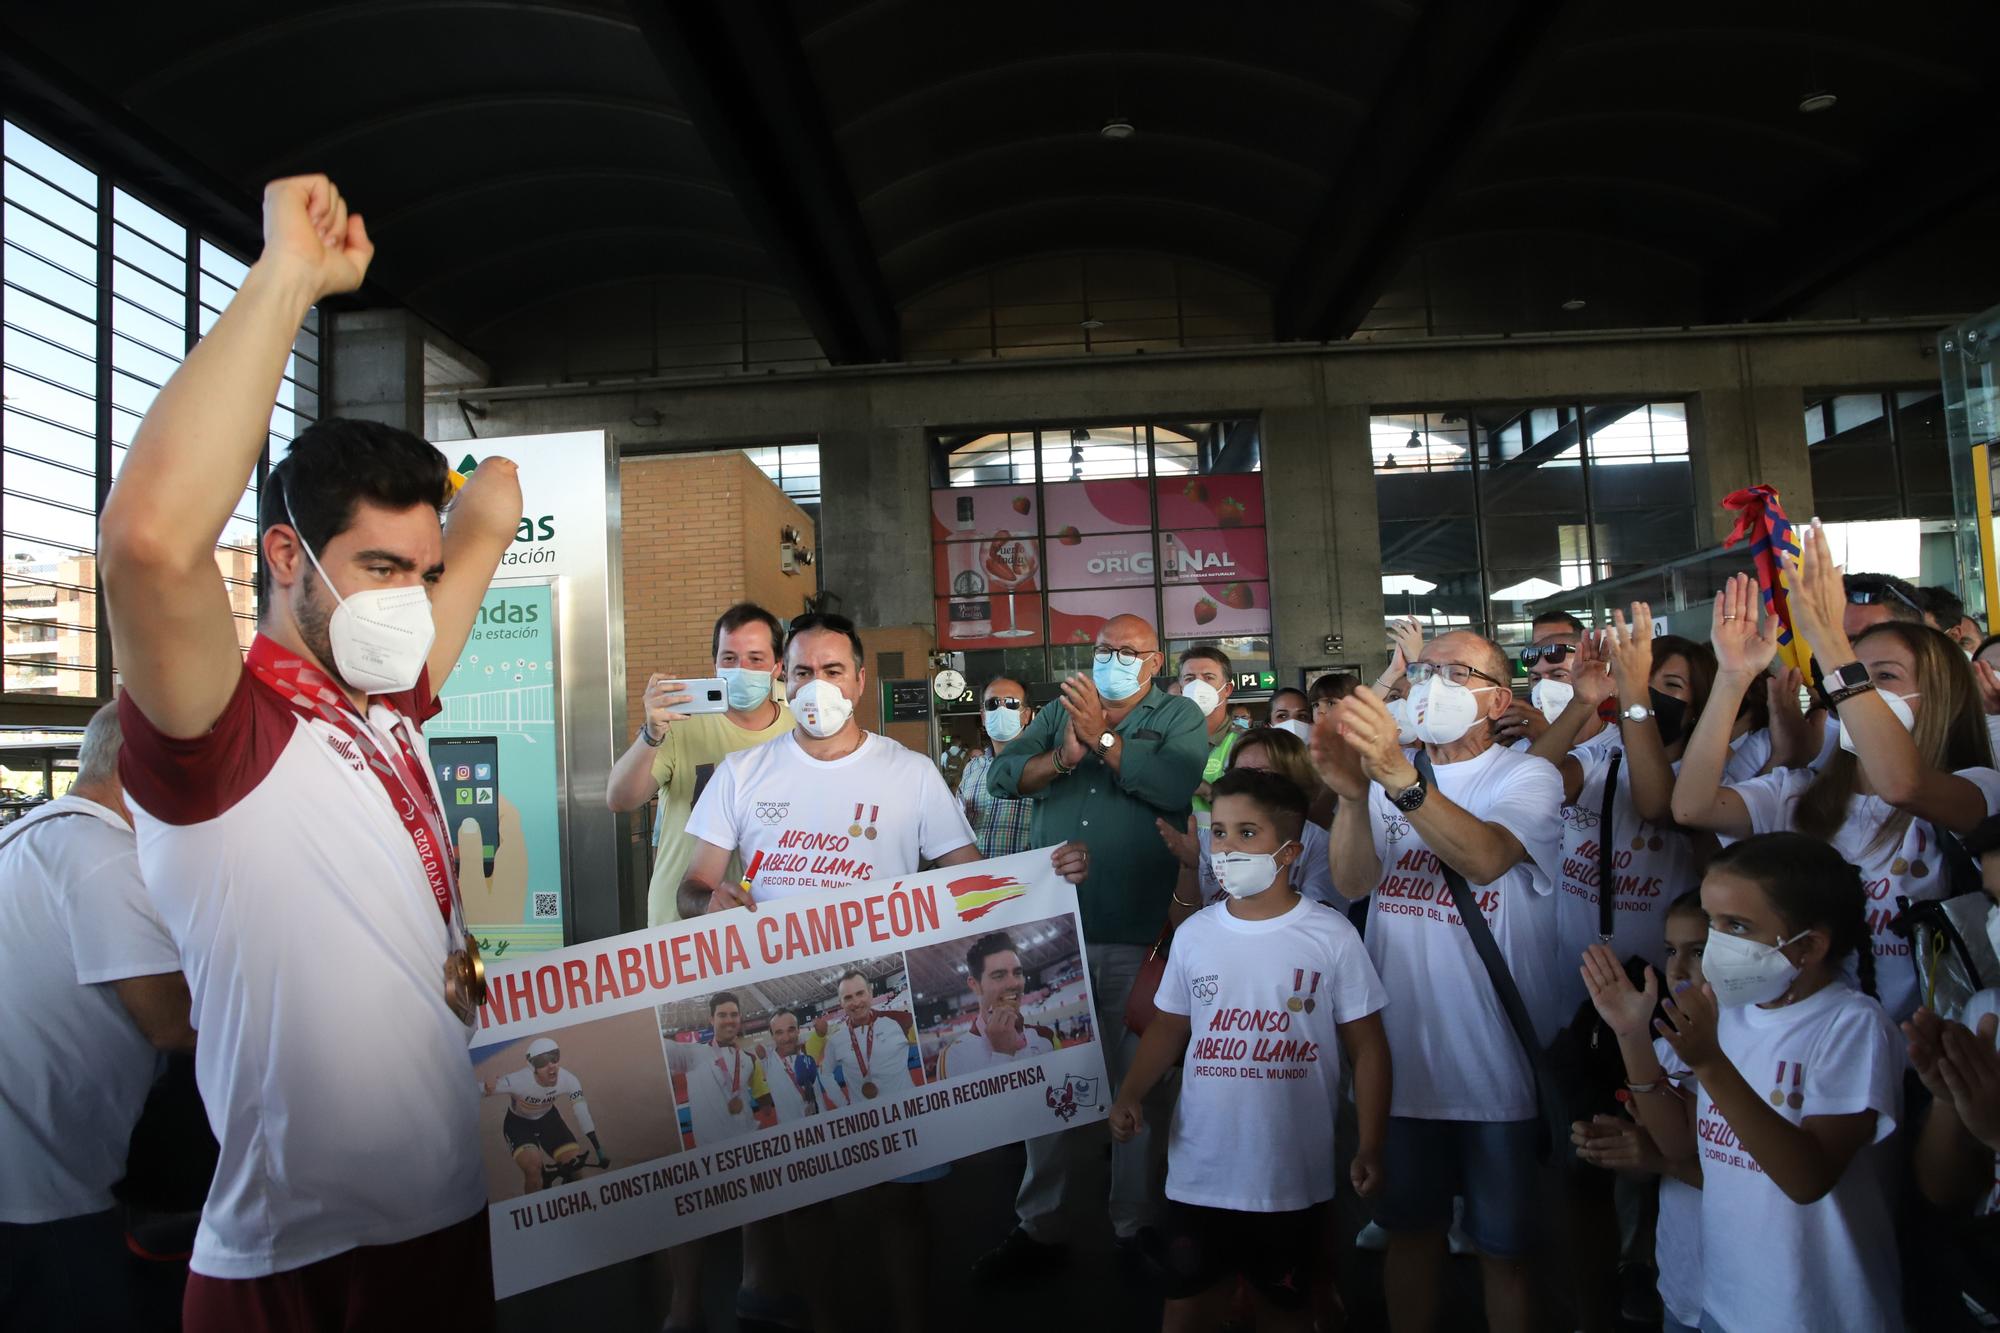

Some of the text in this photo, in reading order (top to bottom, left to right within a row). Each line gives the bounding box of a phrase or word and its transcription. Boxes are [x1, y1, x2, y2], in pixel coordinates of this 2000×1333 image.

[471, 627, 538, 640] la estación
[1241, 674, 1258, 687] P1
[413, 827, 433, 862] 2020
[778, 830, 850, 852] ALFONSO
[758, 853, 874, 881] ABELLO LLAMAS
[424, 861, 449, 904] TOKYO
[798, 877, 818, 887] DEL
[821, 879, 852, 888] MUN
[1427, 908, 1444, 922] DEL
[1615, 902, 1652, 912] UNDO!
[757, 880, 941, 966] CAMPEÓN
[495, 940, 510, 957] y
[1205, 974, 1219, 982] 2020
[1209, 1008, 1291, 1033] ALFONSO
[1193, 1037, 1319, 1063] ABELLO LLAMAS
[1240, 1068, 1263, 1079] DEL
[1266, 1068, 1308, 1080] MUNDO!
[510, 1065, 1046, 1231] TU LUCHA, CONSTANCIA Y ESFUERZO HAN TENIDO LA MEJOR RECOMPENSA
[674, 1128, 918, 1217] ESTAMOS MUY ORGULLOSOS DE TI
